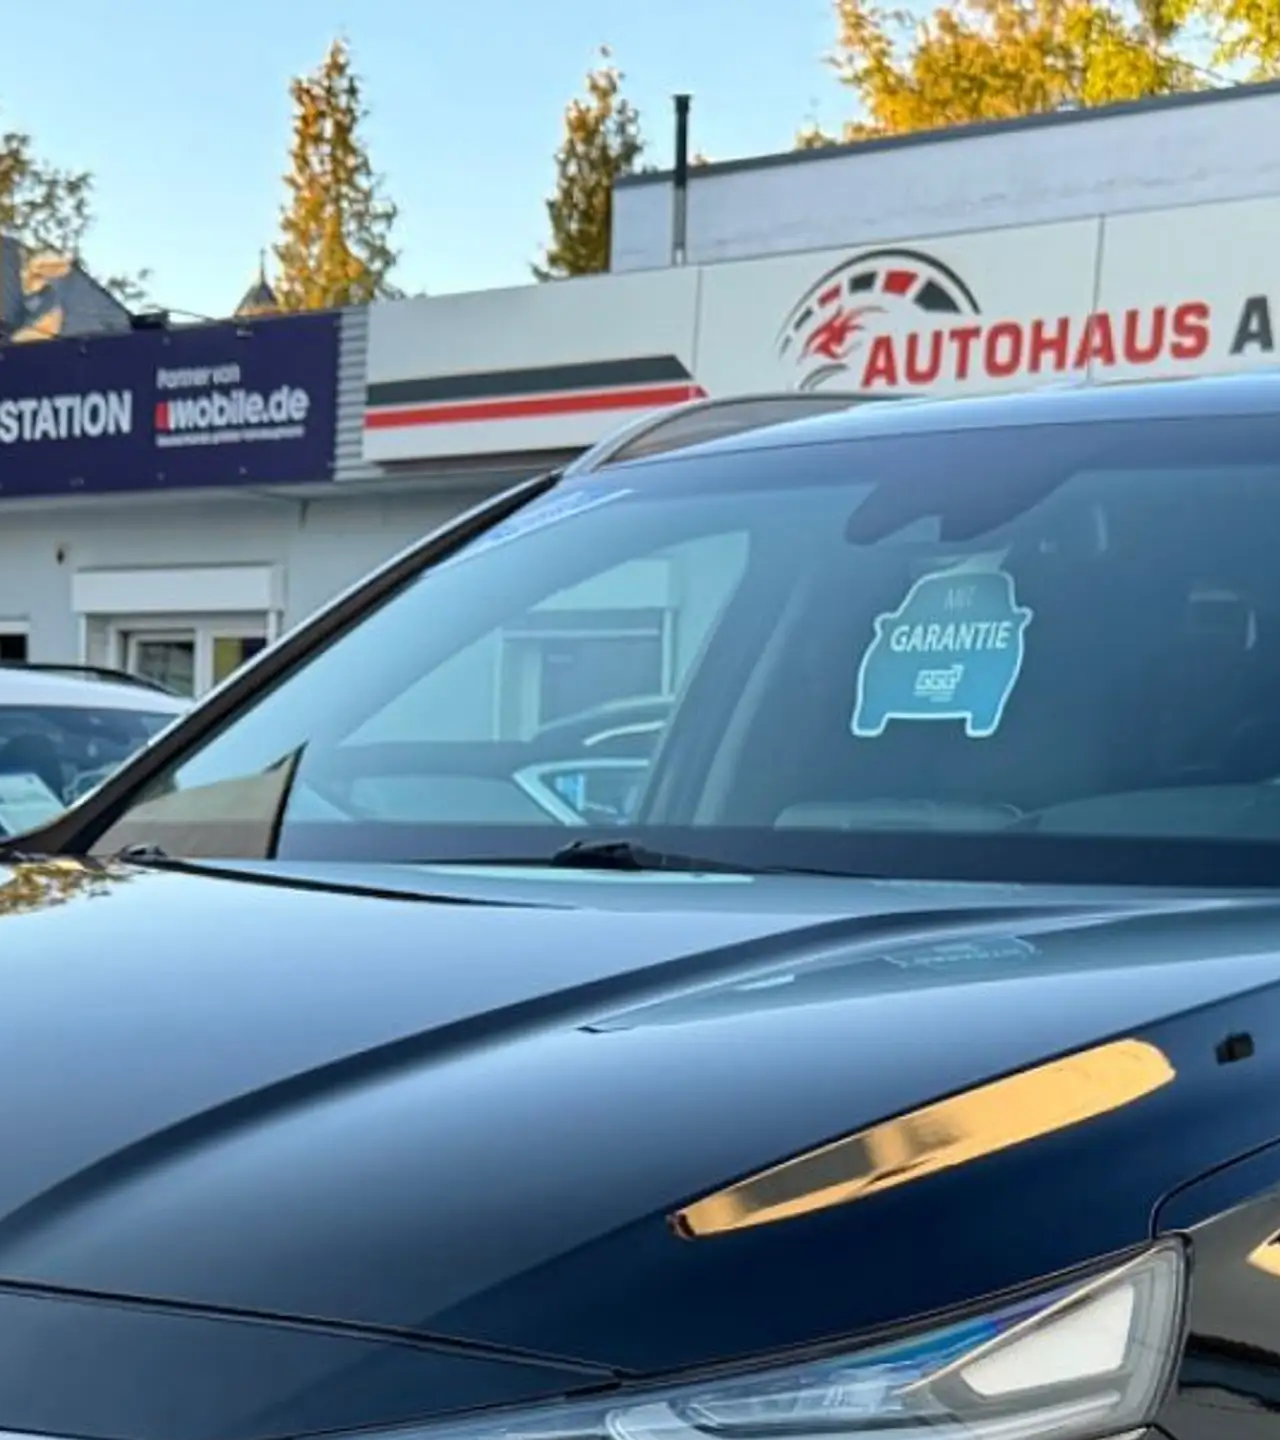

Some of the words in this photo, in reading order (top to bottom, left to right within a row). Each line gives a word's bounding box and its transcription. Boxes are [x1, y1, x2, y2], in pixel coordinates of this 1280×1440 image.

[861, 301, 1212, 389] AUTOHAUS
[156, 366, 210, 390] Partner
[212, 363, 240, 384] von
[167, 384, 310, 431] mobile.de
[889, 620, 1013, 653] GARANTIE
